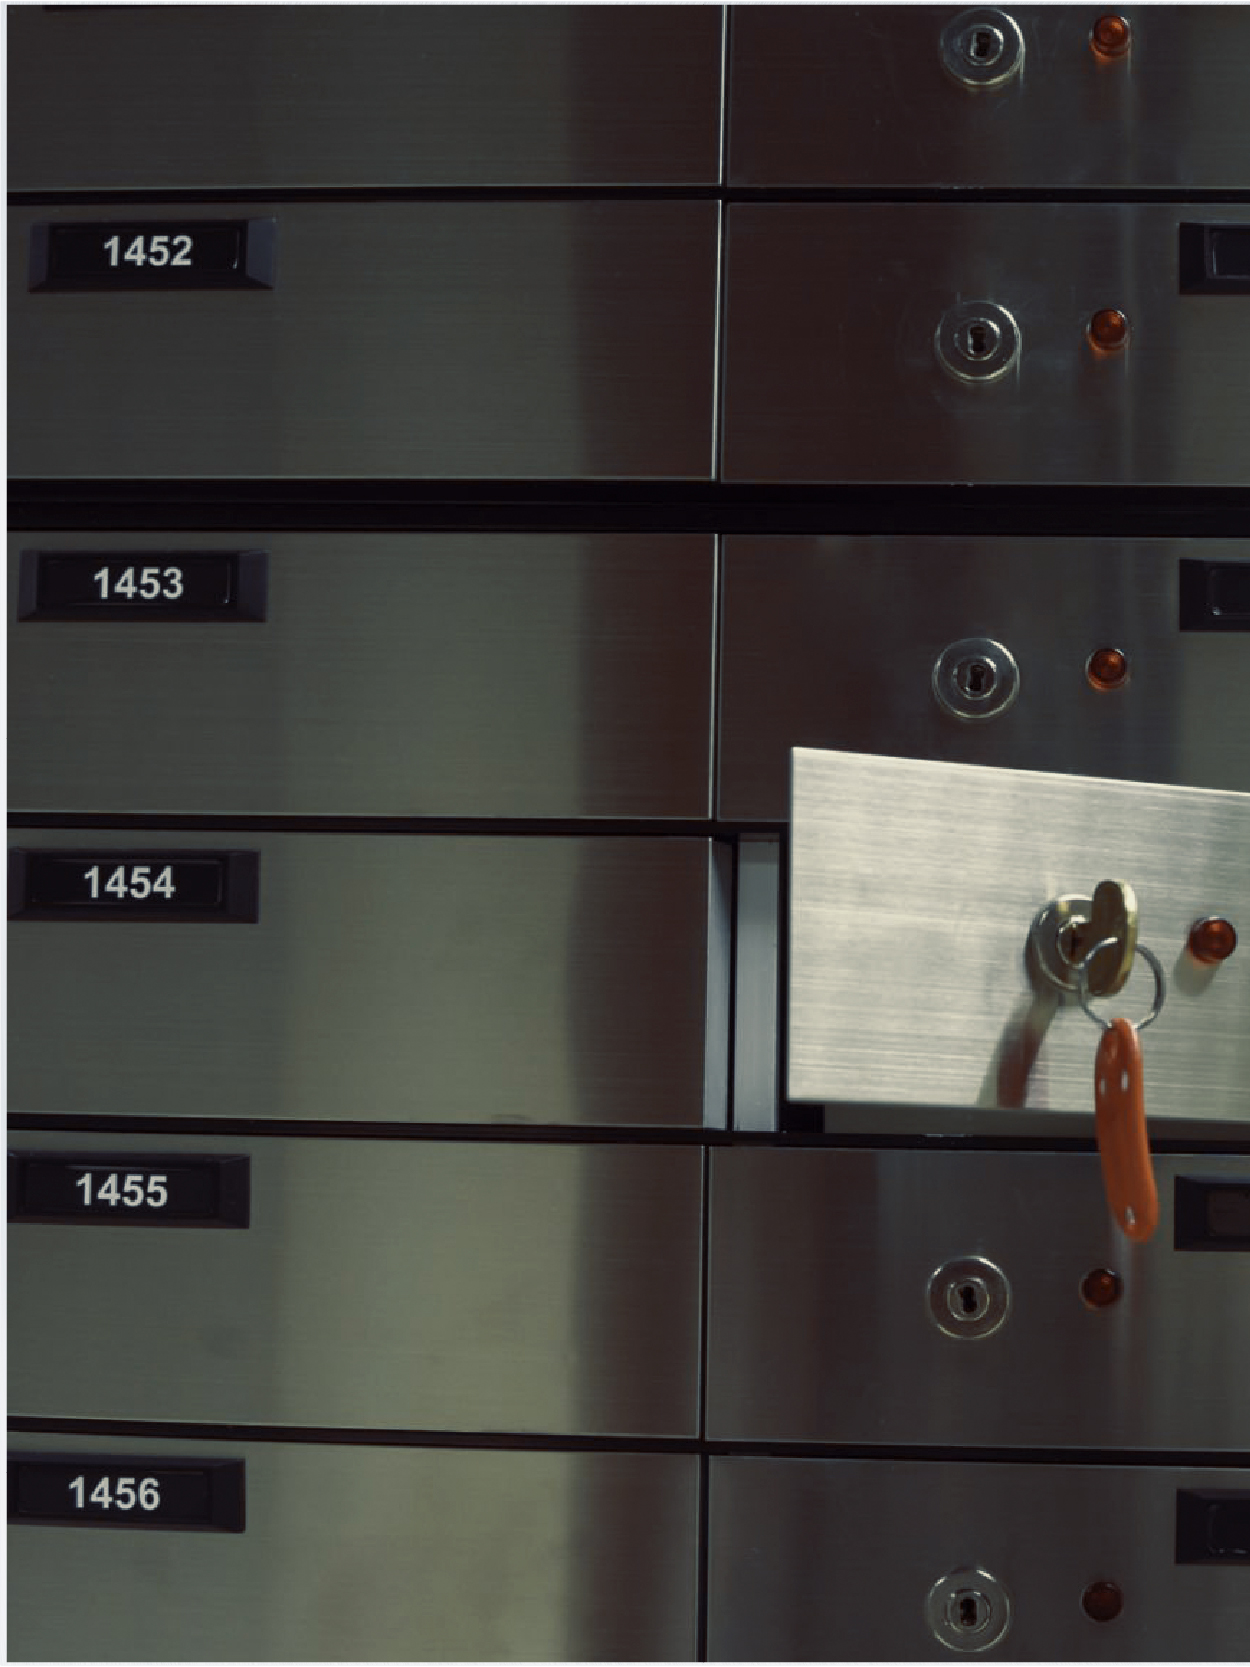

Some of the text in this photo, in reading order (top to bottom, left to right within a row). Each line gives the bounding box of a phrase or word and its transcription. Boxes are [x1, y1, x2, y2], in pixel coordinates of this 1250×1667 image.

[104, 235, 192, 267] 1452
[94, 566, 184, 600] 1453
[84, 865, 177, 899] 1454
[75, 1172, 168, 1208] 1455
[68, 1476, 161, 1511] 1456
